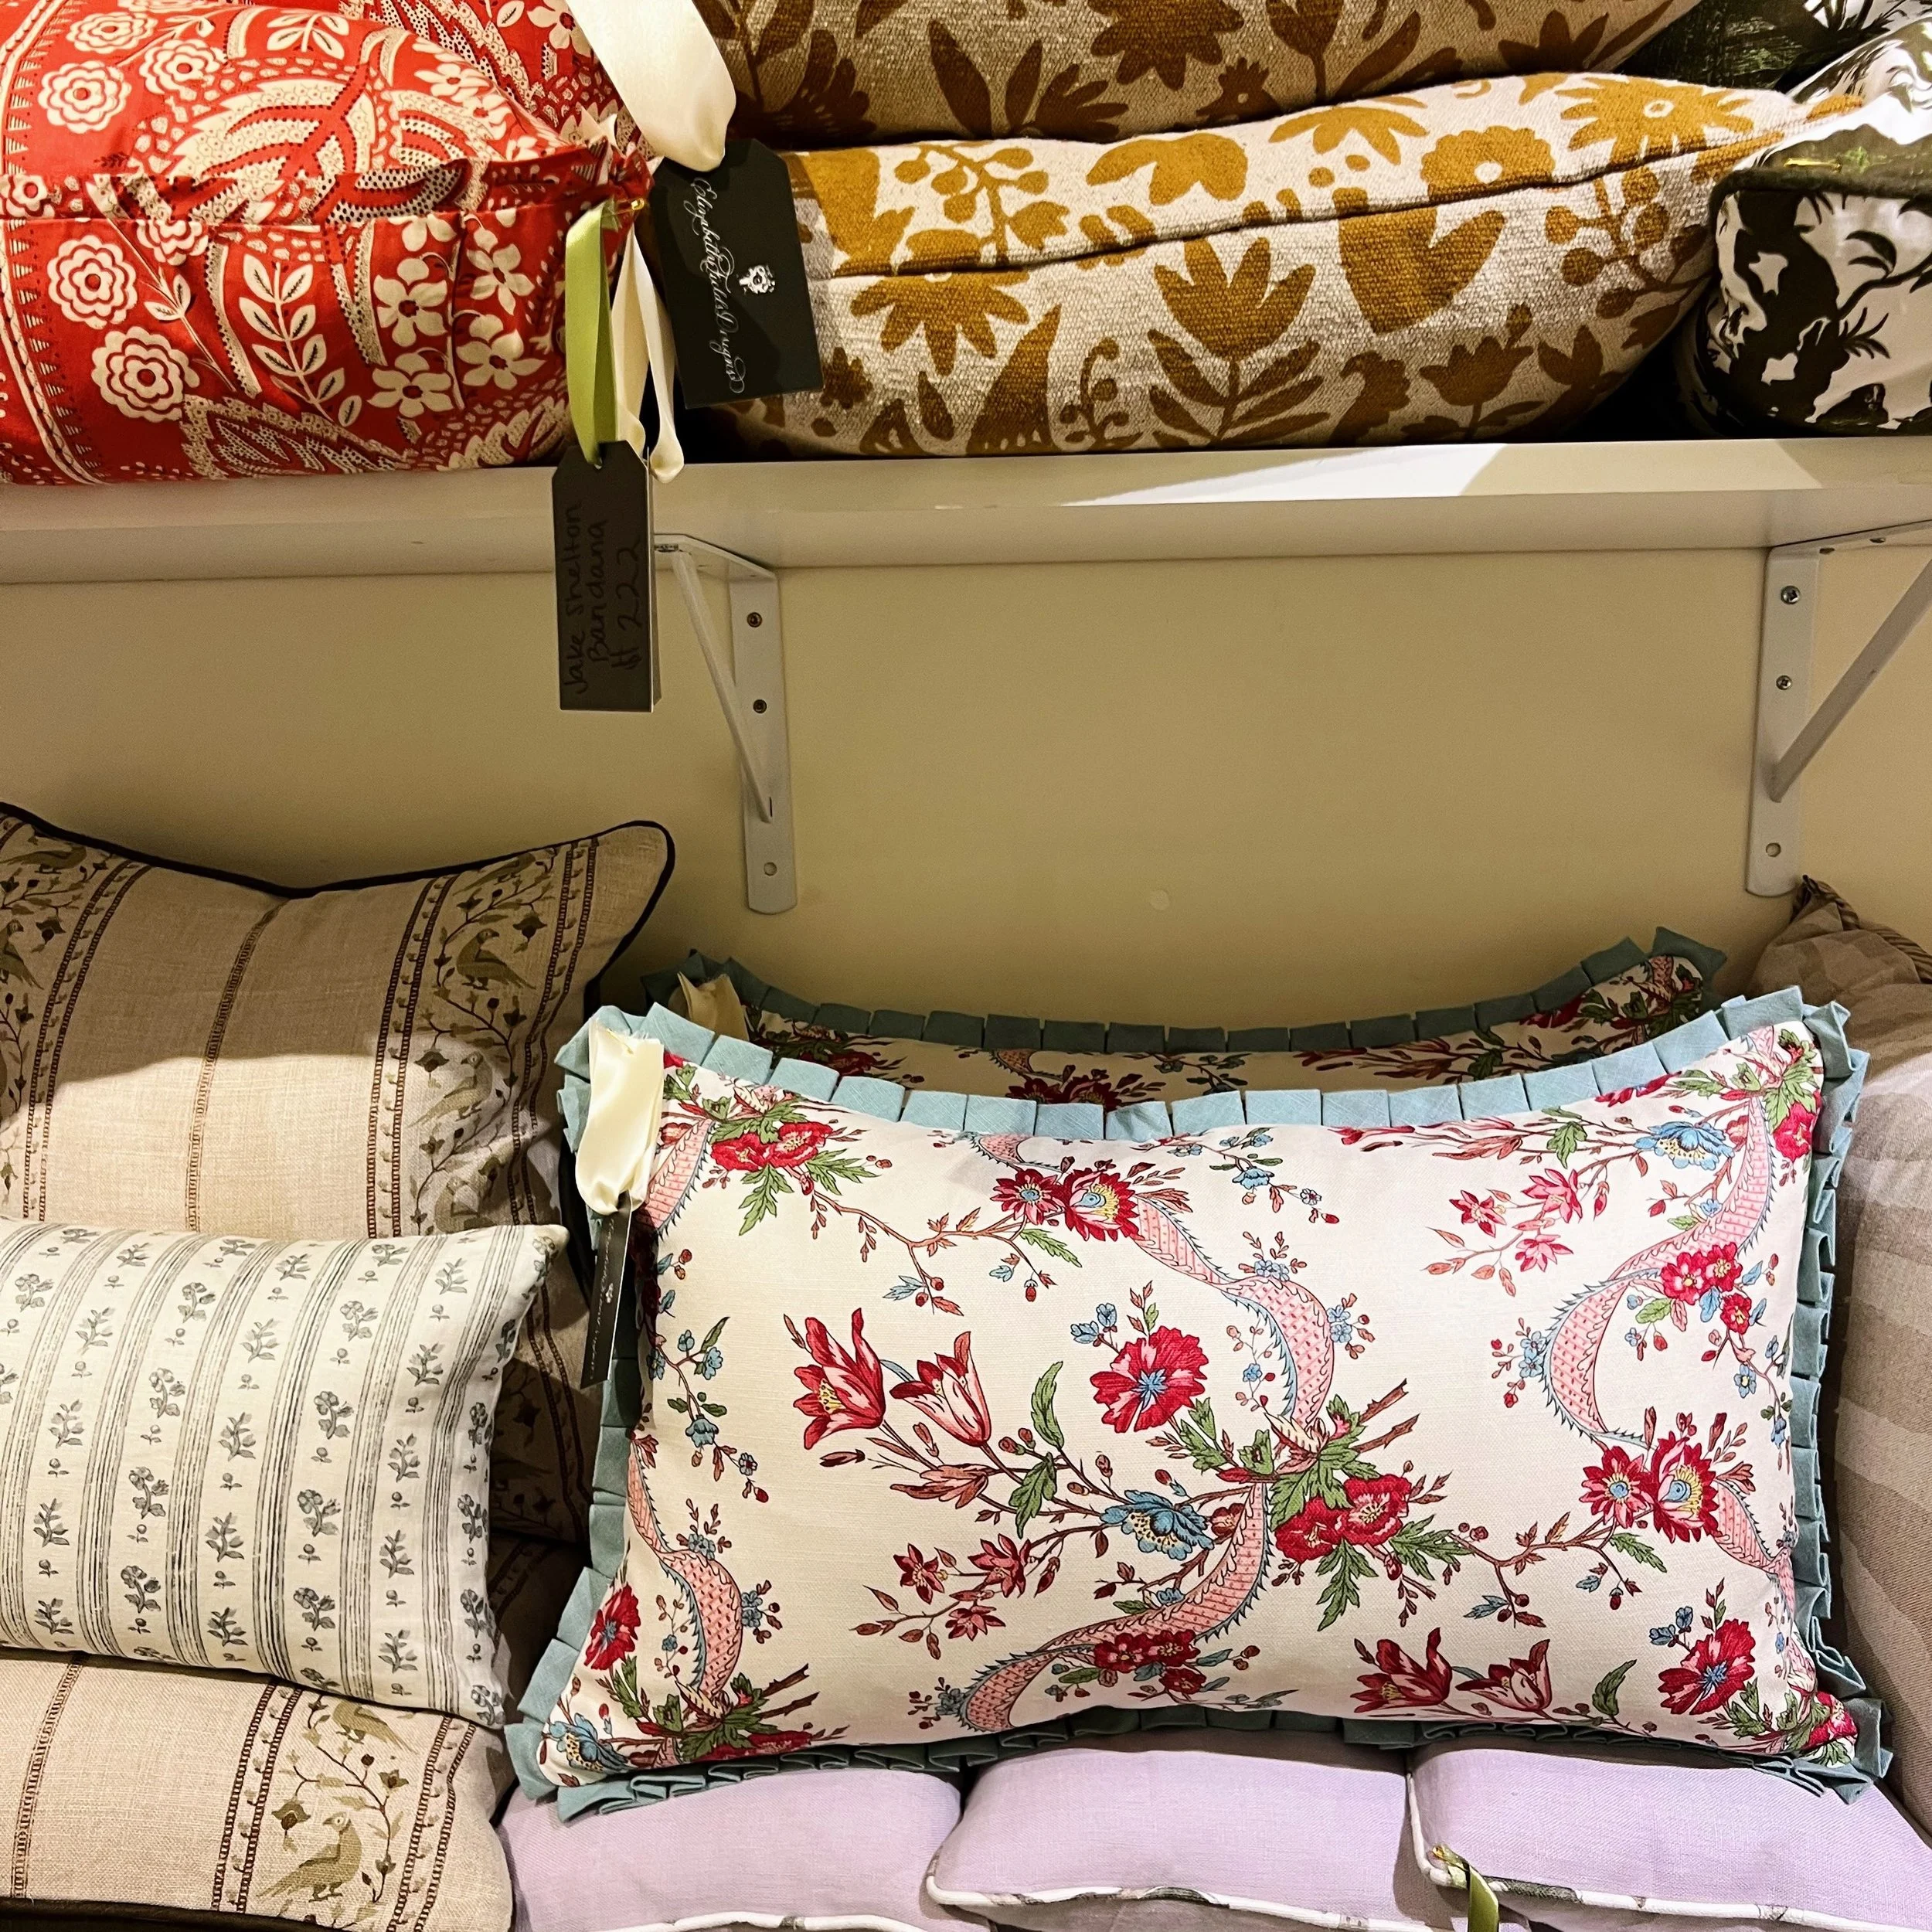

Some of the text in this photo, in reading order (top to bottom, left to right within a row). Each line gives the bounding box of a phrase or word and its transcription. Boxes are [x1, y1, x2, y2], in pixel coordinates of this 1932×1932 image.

[683, 178, 746, 393] Elizabeth Fields Designs
[562, 504, 588, 695] Jake Shelton
[587, 520, 609, 662] Bandana
